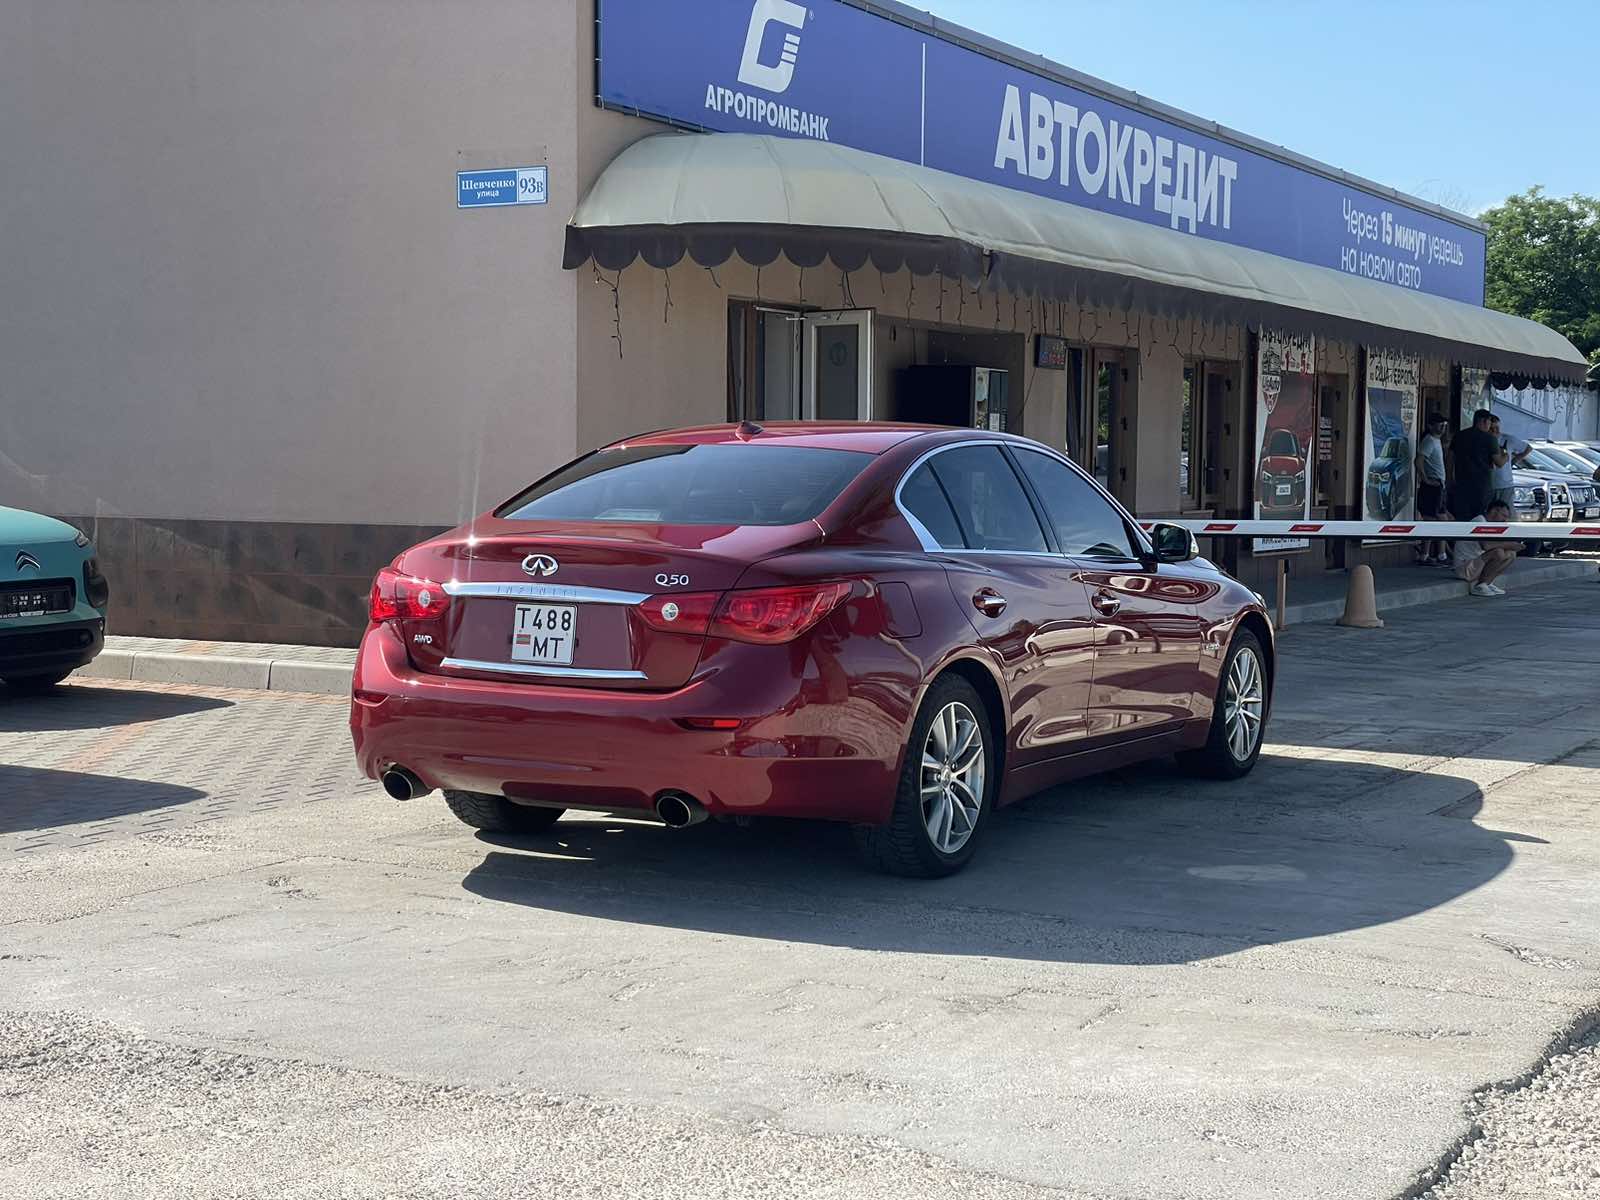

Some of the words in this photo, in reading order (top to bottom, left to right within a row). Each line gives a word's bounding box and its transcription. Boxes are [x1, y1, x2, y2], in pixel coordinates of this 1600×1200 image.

[705, 84, 829, 140] АГРОПРОМБАНК
[994, 84, 1237, 234] АВТОКРЕДИТ
[461, 179, 515, 190] Шевченко
[476, 190, 500, 199] улица
[1342, 198, 1378, 244] Через
[1381, 211, 1393, 246] 15
[1394, 224, 1426, 261] минут
[1427, 234, 1464, 267] уедешь
[1341, 247, 1357, 273] на
[1360, 251, 1395, 283] новом
[1397, 262, 1422, 289] авто
[655, 573, 689, 586] Q50
[517, 607, 571, 631] T488
[413, 634, 433, 645] AWD
[532, 636, 564, 658] MT
